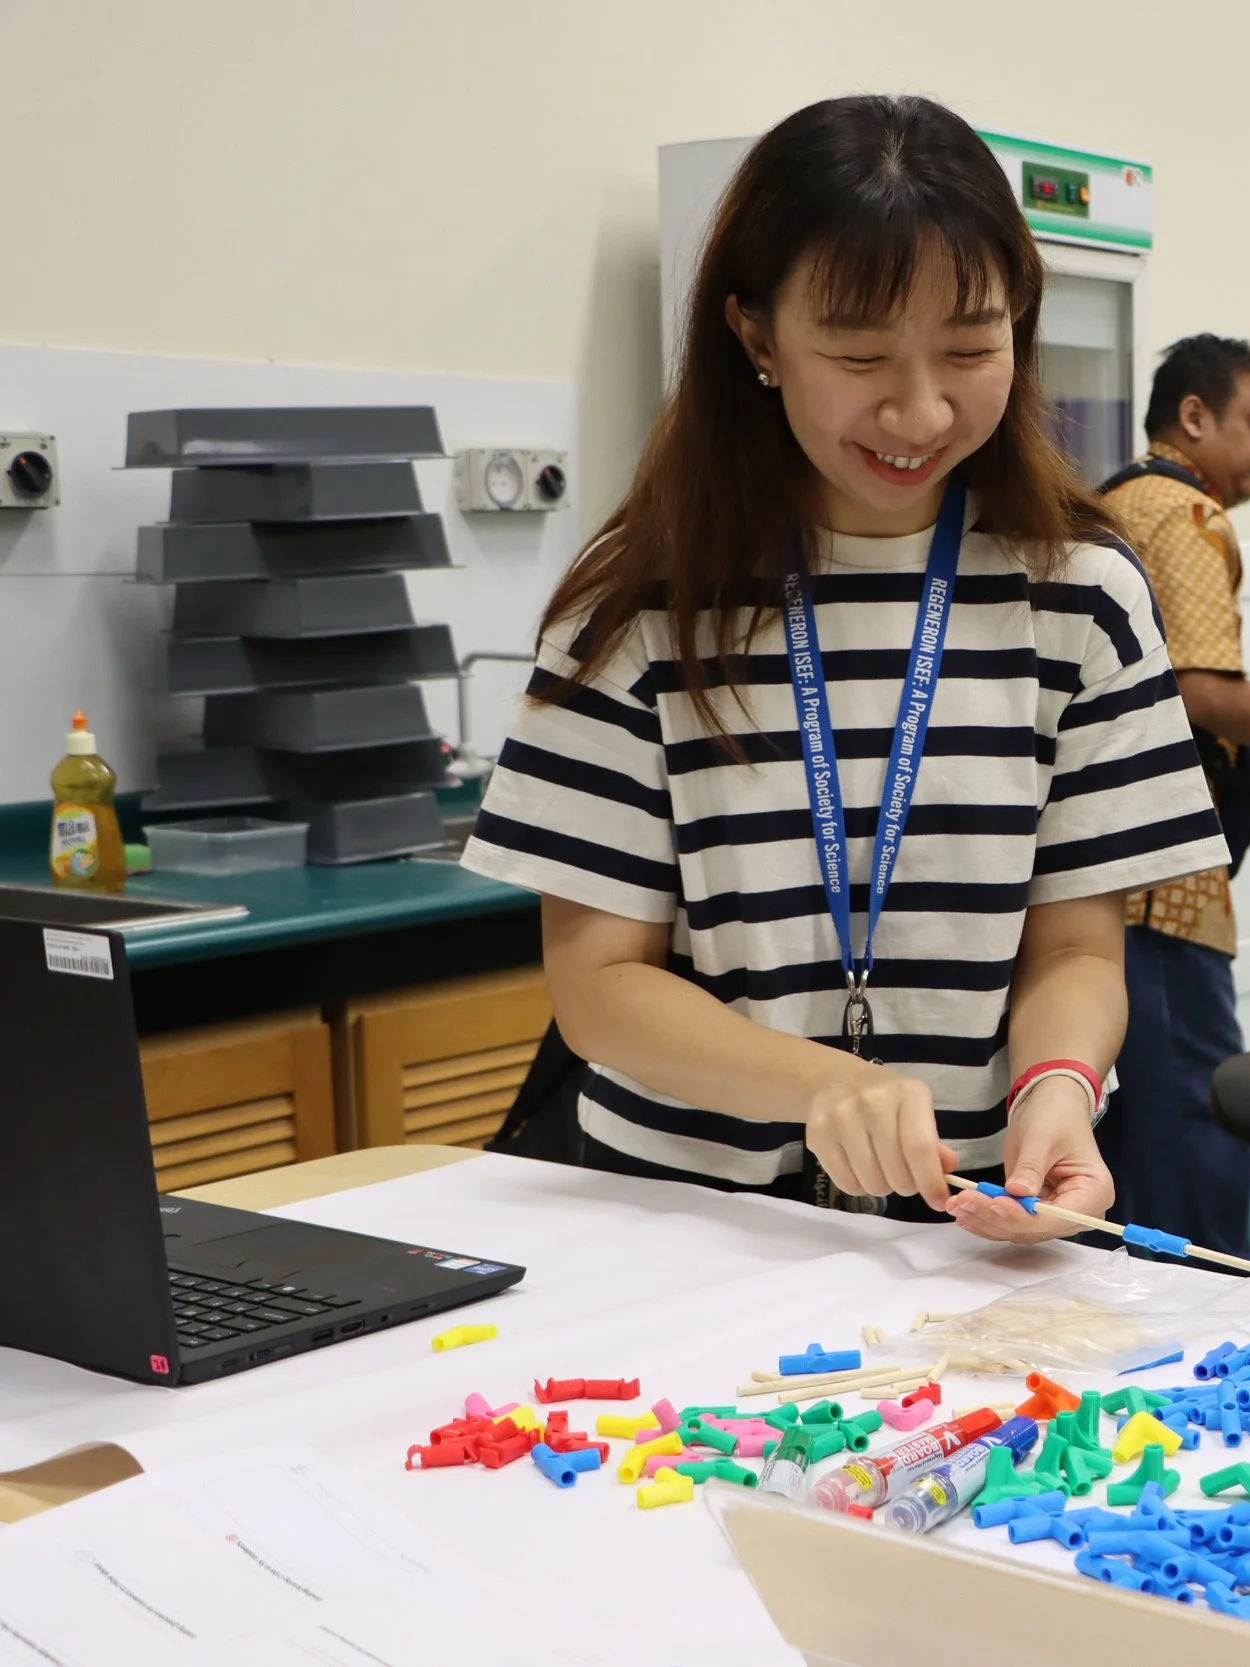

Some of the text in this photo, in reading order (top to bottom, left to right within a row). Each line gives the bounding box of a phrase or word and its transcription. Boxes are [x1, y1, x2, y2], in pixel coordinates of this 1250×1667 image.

[794, 651, 815, 684] ISEF:
[801, 687, 818, 697] A
[803, 698, 824, 753] Program
[876, 577, 947, 895] REGENERON ISEF: A Program of Society for Science
[812, 755, 829, 769] of
[814, 771, 835, 819] Society
[821, 821, 837, 841] for
[825, 843, 842, 893] Science
[893, 1434, 936, 1456] MASTER
[902, 1442, 940, 1465] BOARD
[957, 1444, 987, 1467] BOARD
